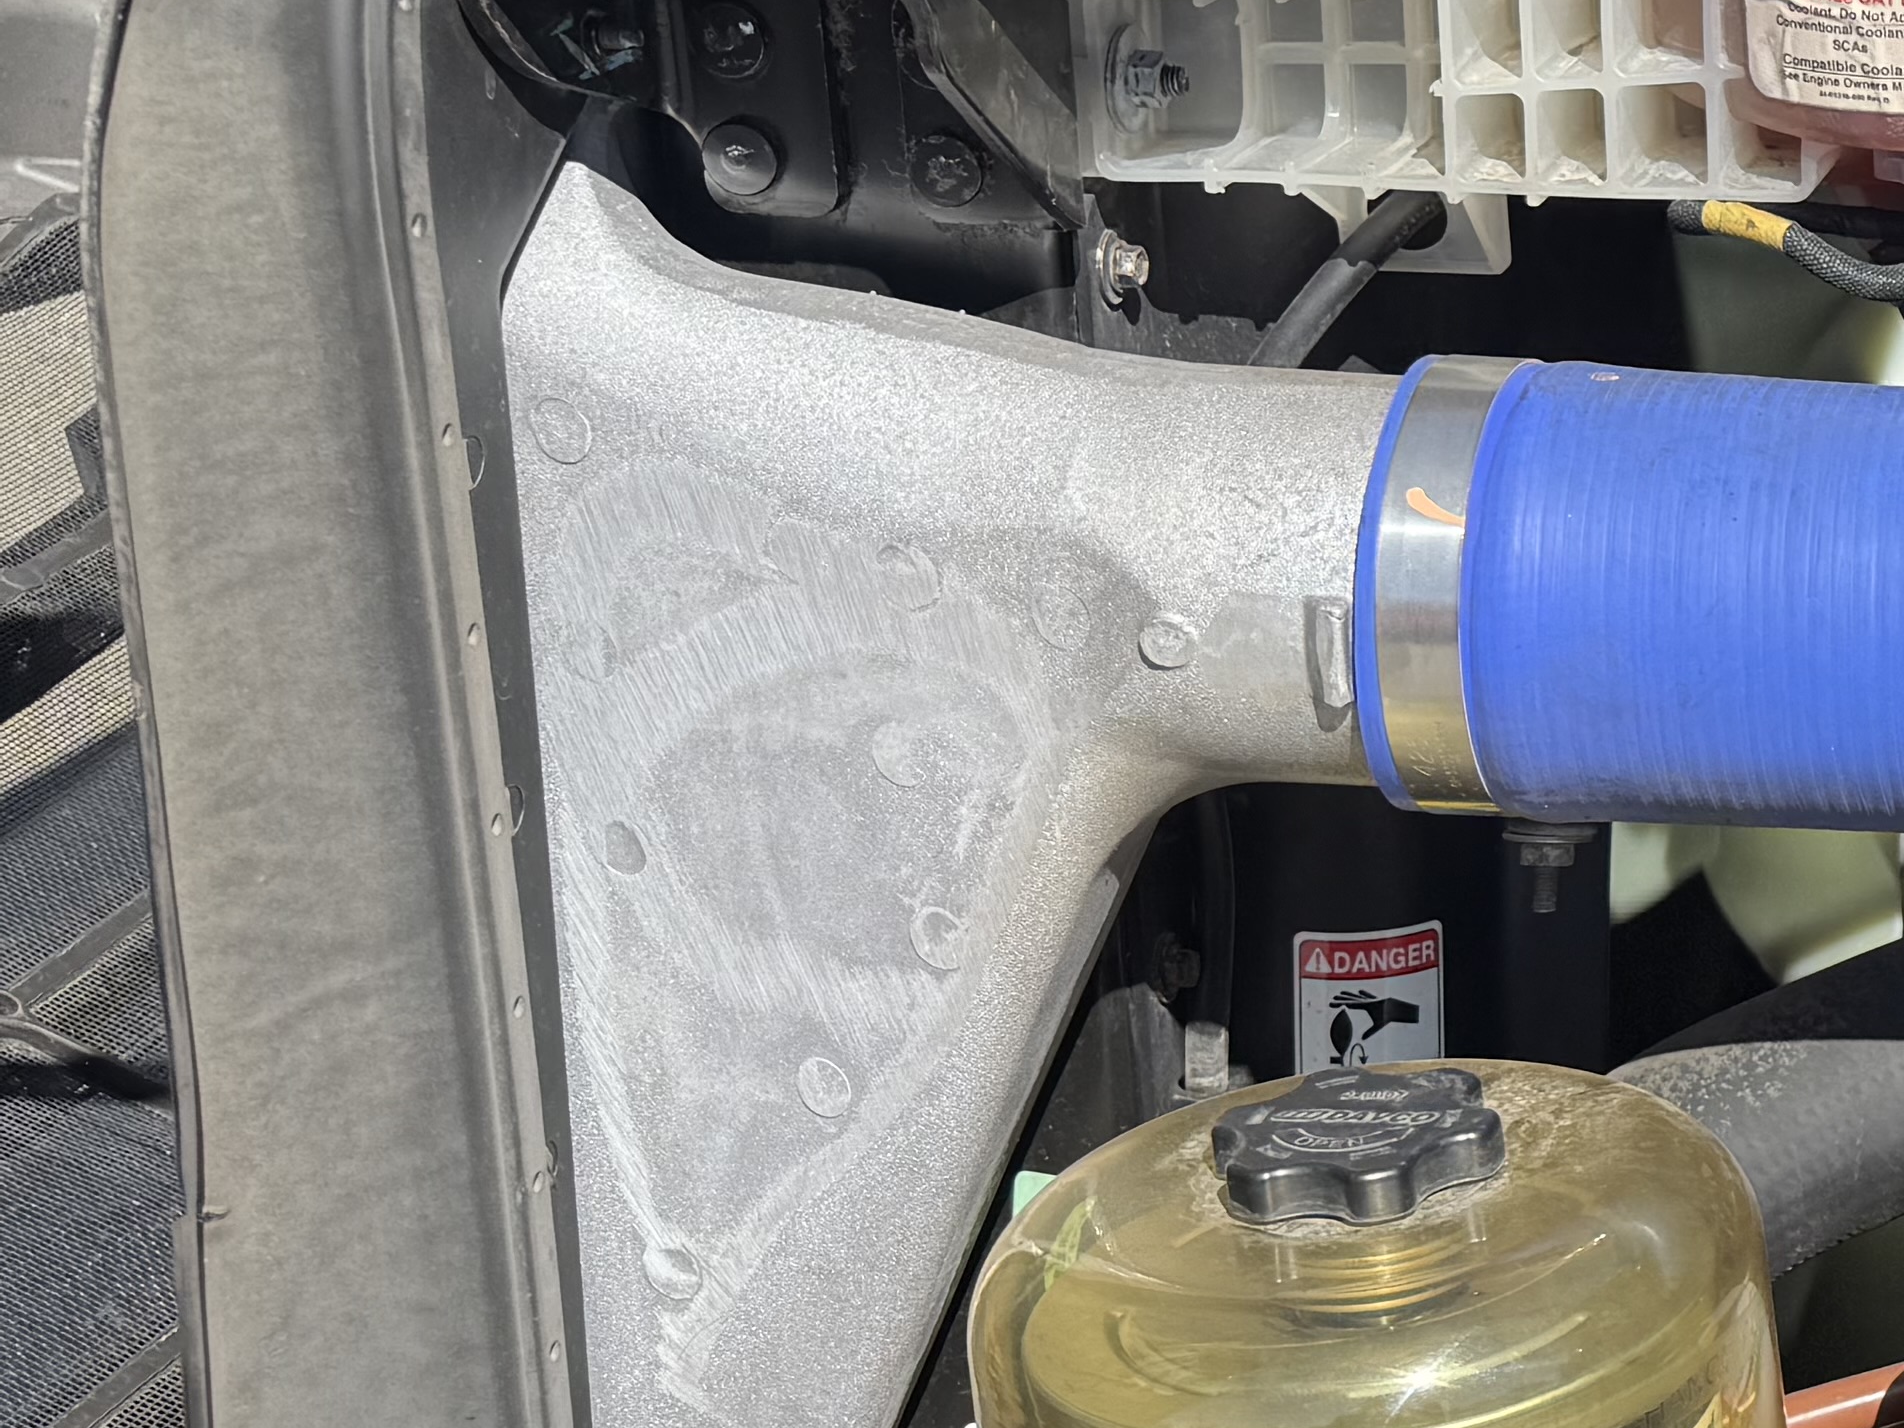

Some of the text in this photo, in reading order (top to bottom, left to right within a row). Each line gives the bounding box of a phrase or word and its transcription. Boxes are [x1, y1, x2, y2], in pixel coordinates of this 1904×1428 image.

[1840, 8, 1857, 20] Do
[1861, 10, 1884, 22] Not
[1776, 15, 1852, 36] Conventional
[1833, 39, 1868, 54] SCAs
[1783, 53, 1857, 75] Compatible
[1802, 72, 1840, 88] Engine
[1843, 77, 1888, 91] Owners
[1334, 940, 1435, 973] DANGER
[1294, 1135, 1364, 1149] OPEN
